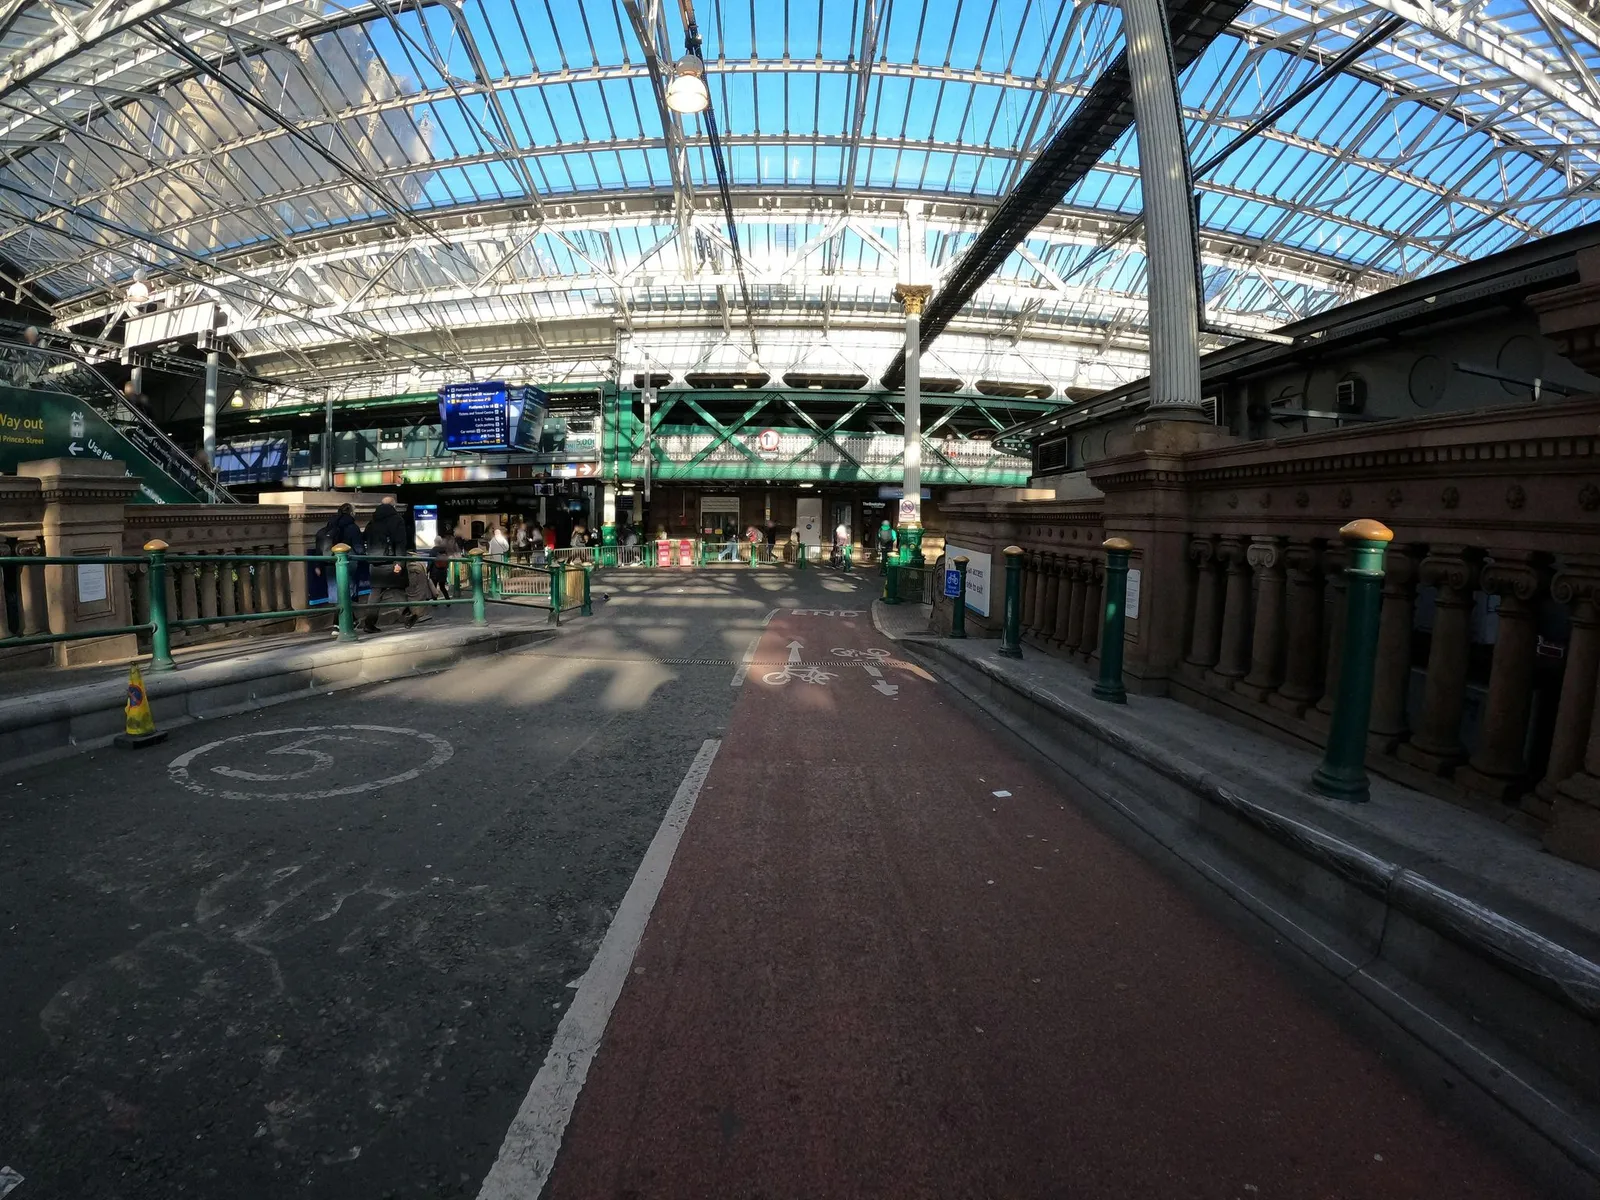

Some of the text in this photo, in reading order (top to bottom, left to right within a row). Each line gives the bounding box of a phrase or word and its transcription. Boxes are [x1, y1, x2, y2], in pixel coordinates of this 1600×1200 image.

[23, 418, 44, 430] out
[3, 435, 25, 443] Princes
[26, 436, 44, 444] Street
[87, 439, 102, 457] Use
